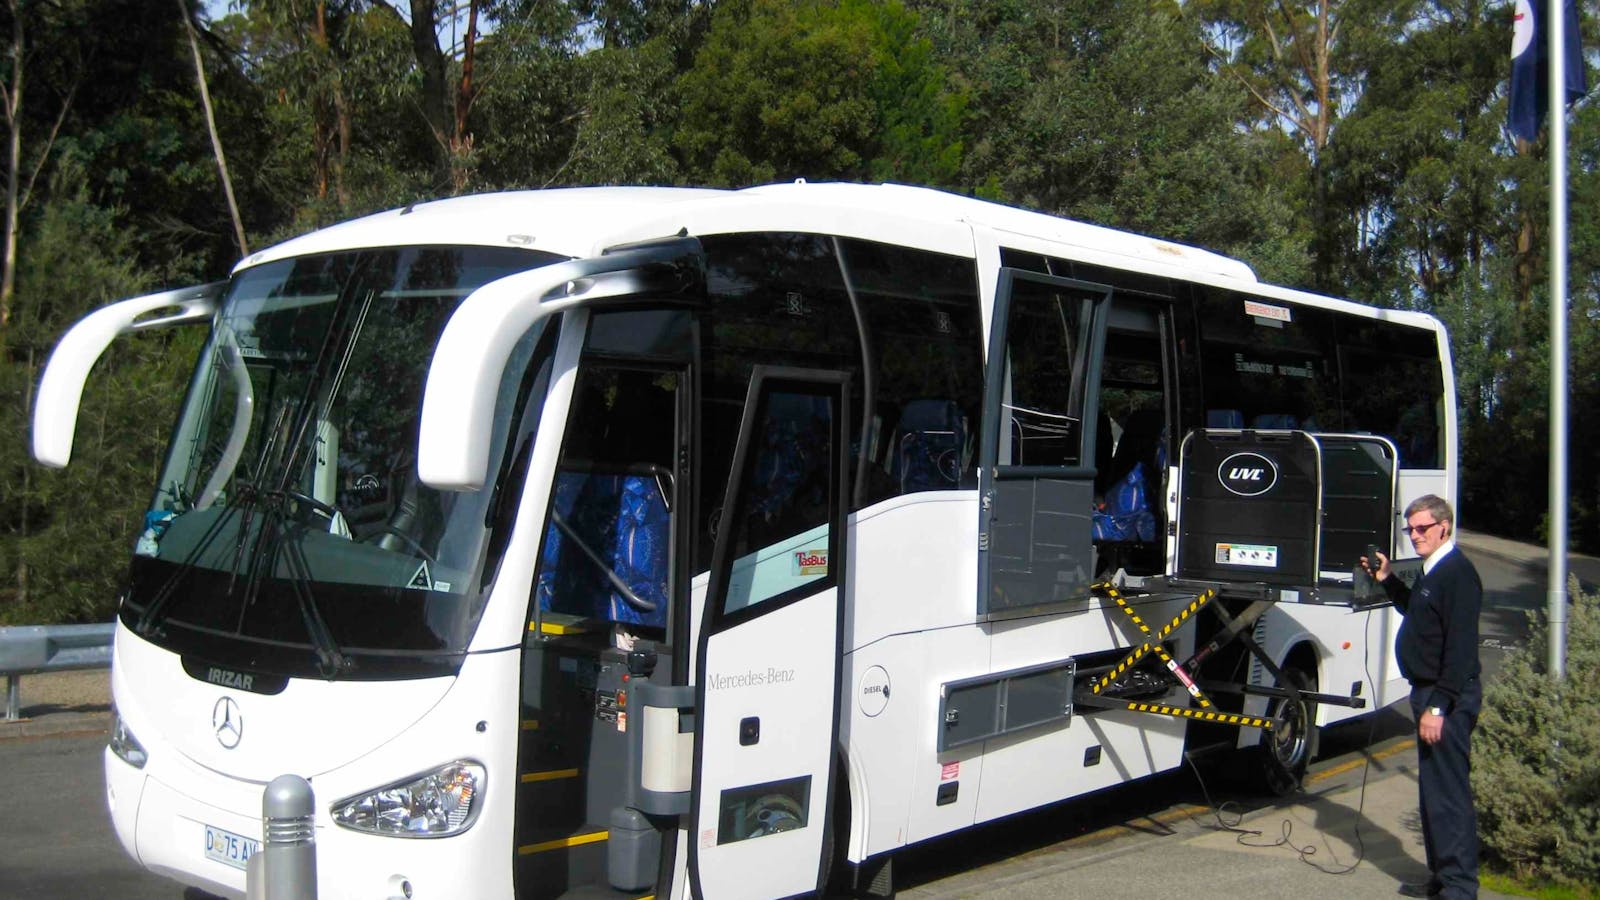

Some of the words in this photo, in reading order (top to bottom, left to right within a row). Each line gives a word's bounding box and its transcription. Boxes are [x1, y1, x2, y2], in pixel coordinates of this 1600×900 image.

[208, 667, 253, 690] IRIZAR
[708, 667, 794, 691] Mercedes-Benz
[864, 685, 881, 694] DIESEL
[224, 835, 238, 859] 75
